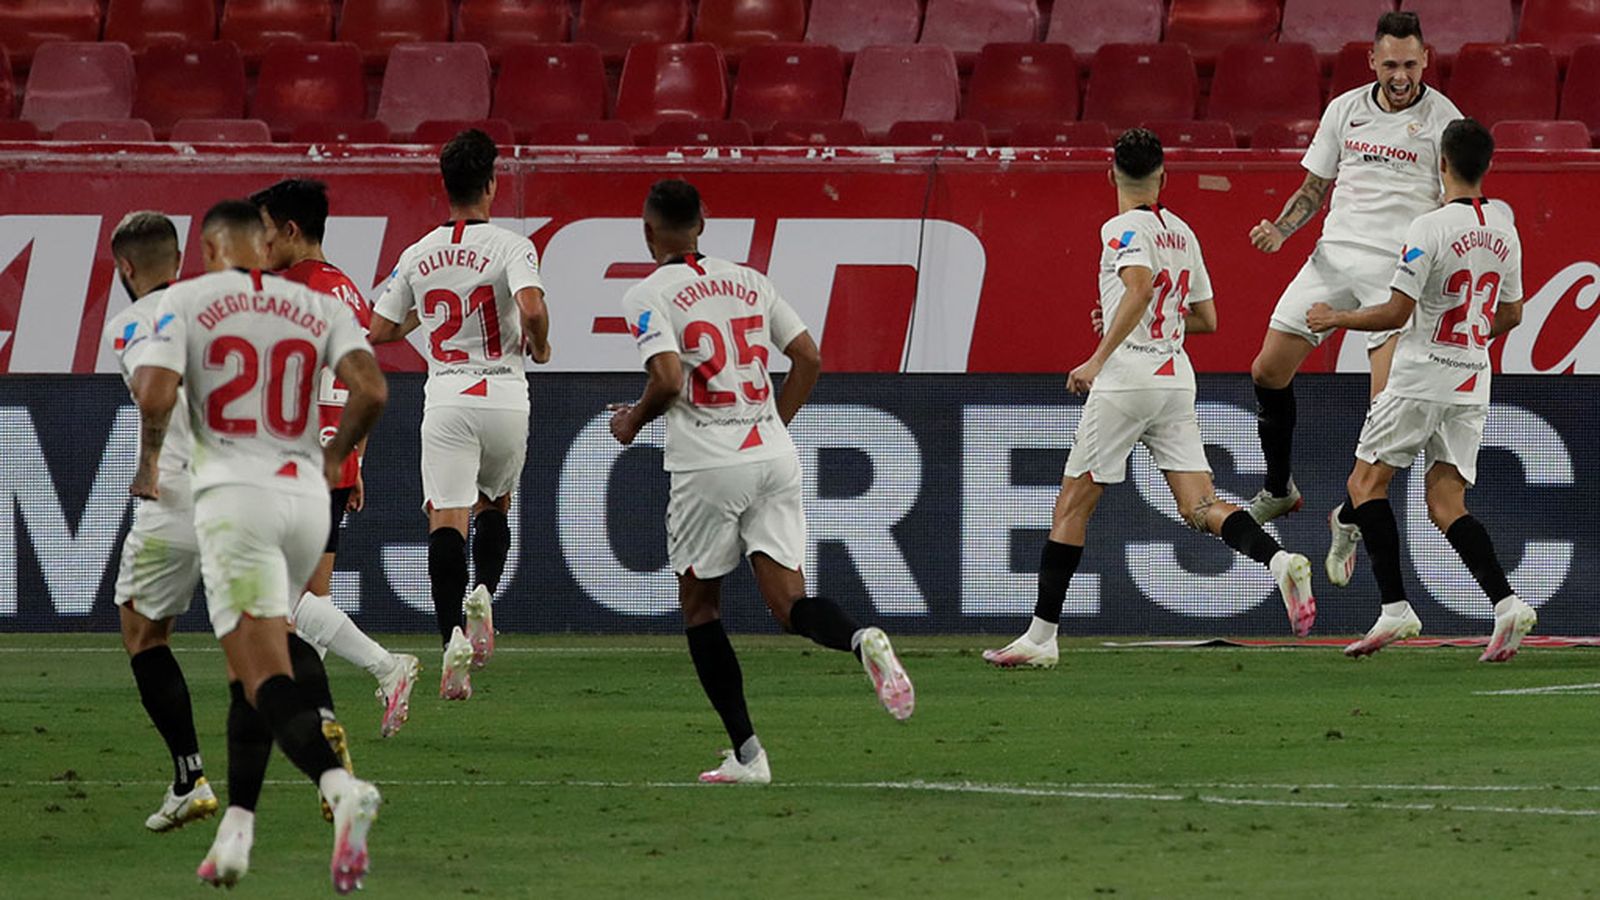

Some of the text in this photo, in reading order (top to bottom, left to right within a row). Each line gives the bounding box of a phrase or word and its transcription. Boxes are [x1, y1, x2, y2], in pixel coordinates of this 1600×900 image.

[1344, 140, 1418, 163] MARATHON
[418, 249, 490, 276] OLIVER.T
[423, 284, 502, 364] 21
[1431, 268, 1500, 350] 23
[202, 334, 318, 441] 20
[679, 314, 769, 408] 25
